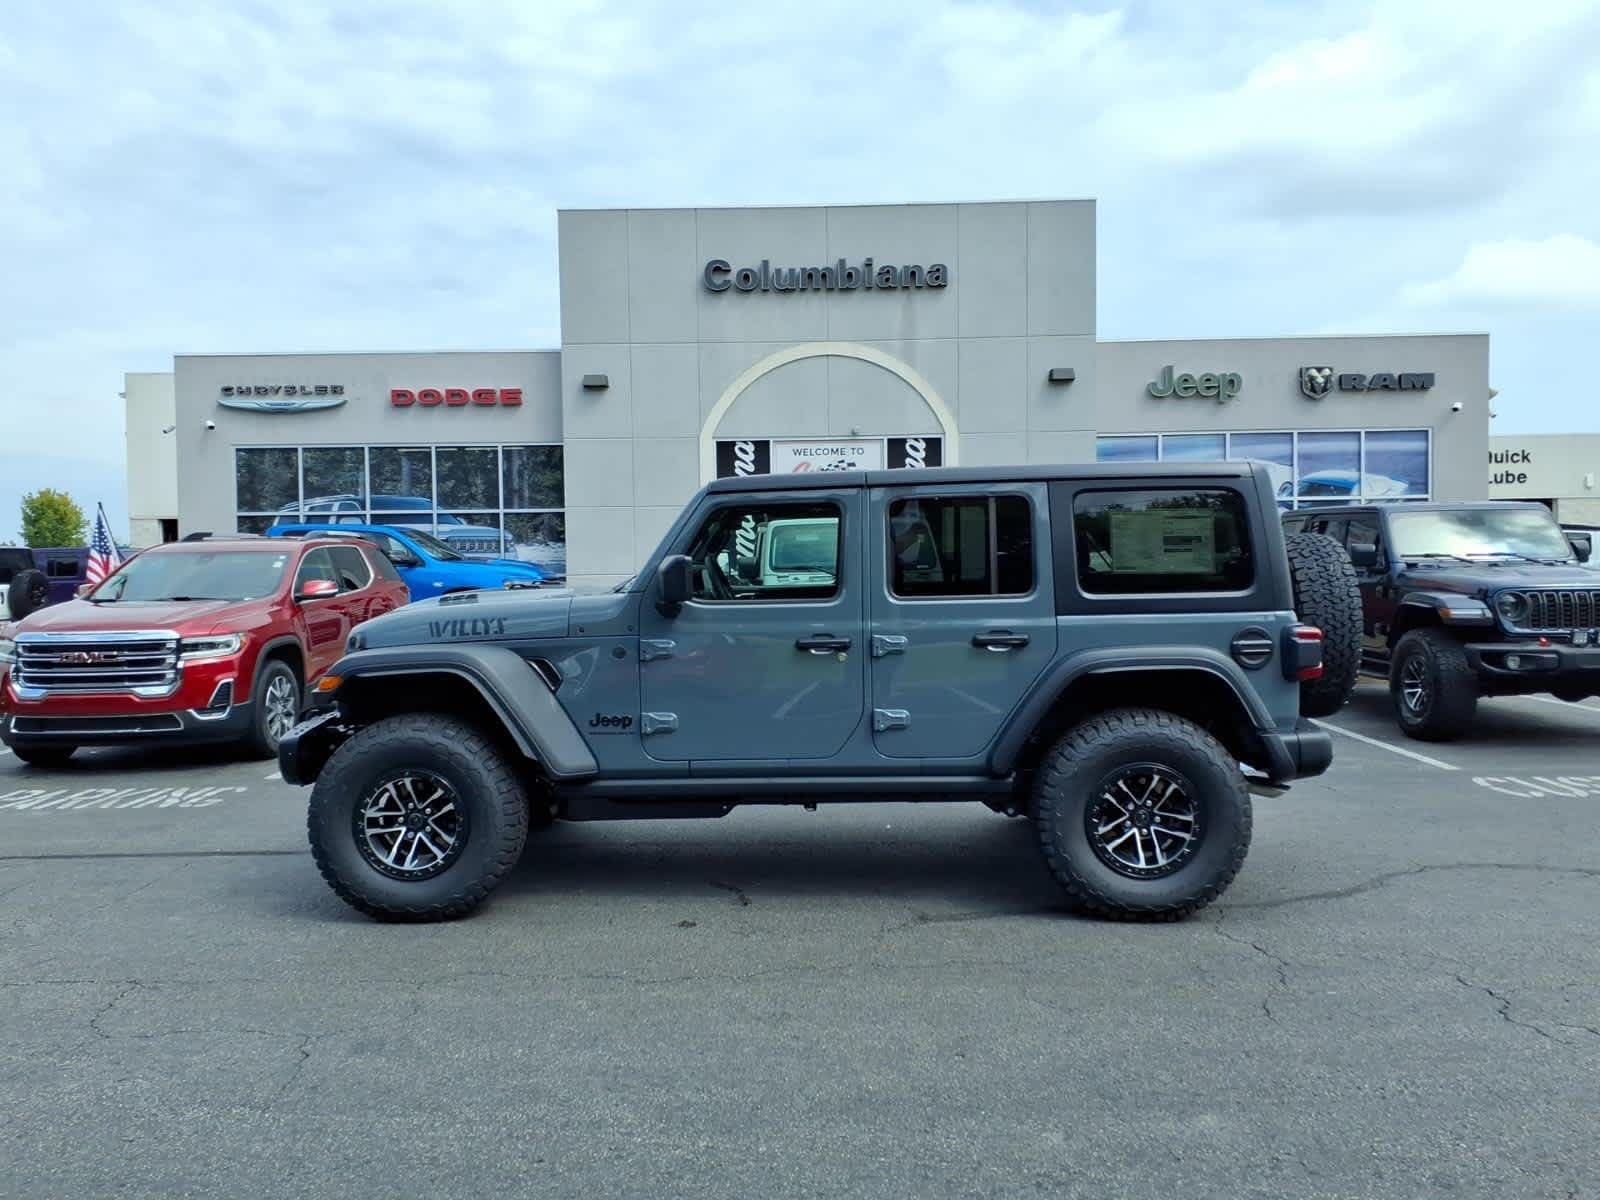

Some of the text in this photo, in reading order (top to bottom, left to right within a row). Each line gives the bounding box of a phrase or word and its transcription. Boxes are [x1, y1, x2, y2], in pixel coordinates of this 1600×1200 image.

[703, 257, 948, 293] Columbiana
[221, 384, 345, 396] CHRYSLER
[1148, 365, 1242, 404] Jeep
[1339, 372, 1435, 391] RAM
[391, 388, 523, 407] DODGE
[792, 447, 865, 457] WELCOME TO
[1488, 449, 1531, 464] uick
[1488, 470, 1527, 484] ube
[429, 617, 508, 638] WILLYS
[60, 651, 117, 663] GMC
[590, 712, 632, 730] Jeep
